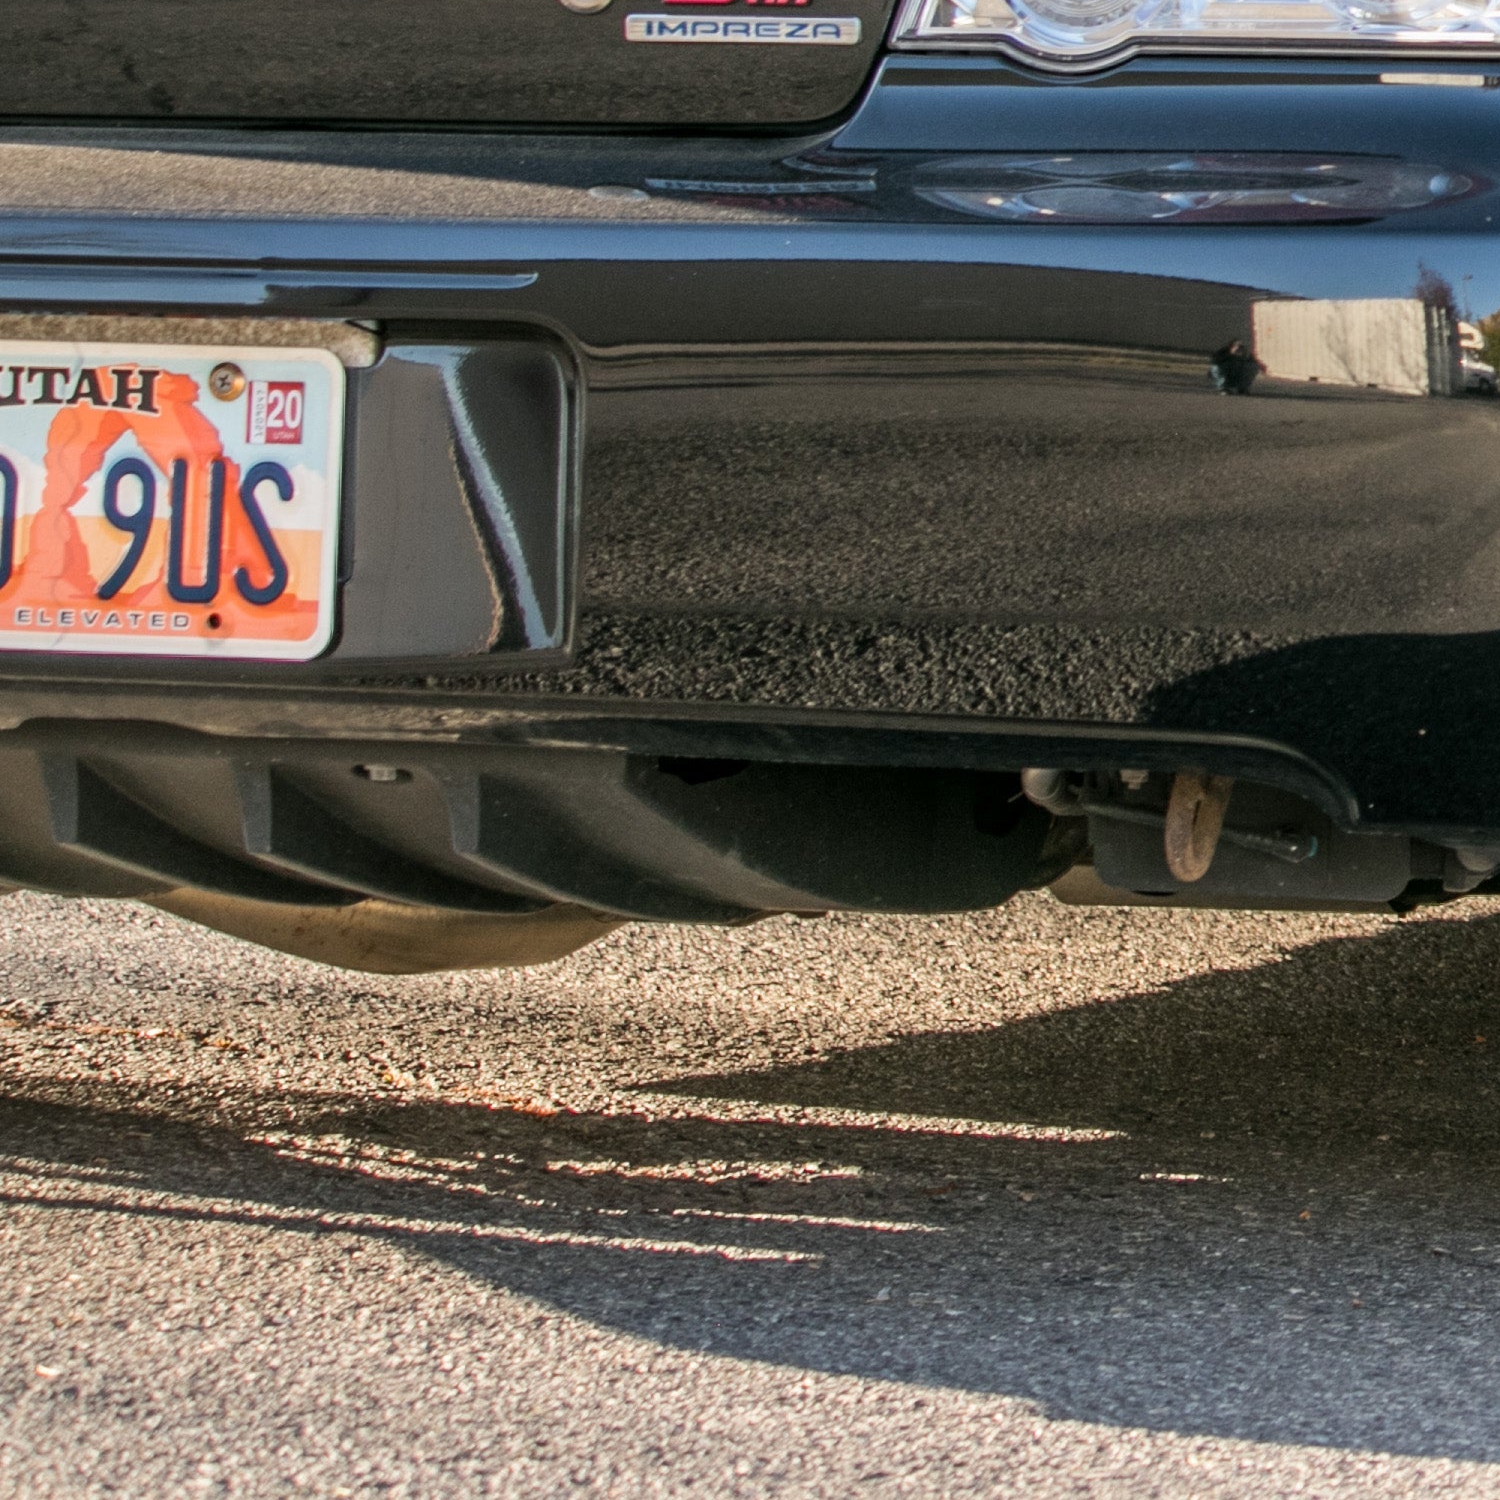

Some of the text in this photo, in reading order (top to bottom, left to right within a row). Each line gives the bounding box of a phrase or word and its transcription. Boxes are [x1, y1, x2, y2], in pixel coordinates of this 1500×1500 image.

[644, 20, 842, 39] IMPREZA
[0, 366, 160, 413] UTAH
[266, 389, 303, 429] 20
[97, 457, 296, 606] 9US
[15, 608, 192, 630] ELEVATED
